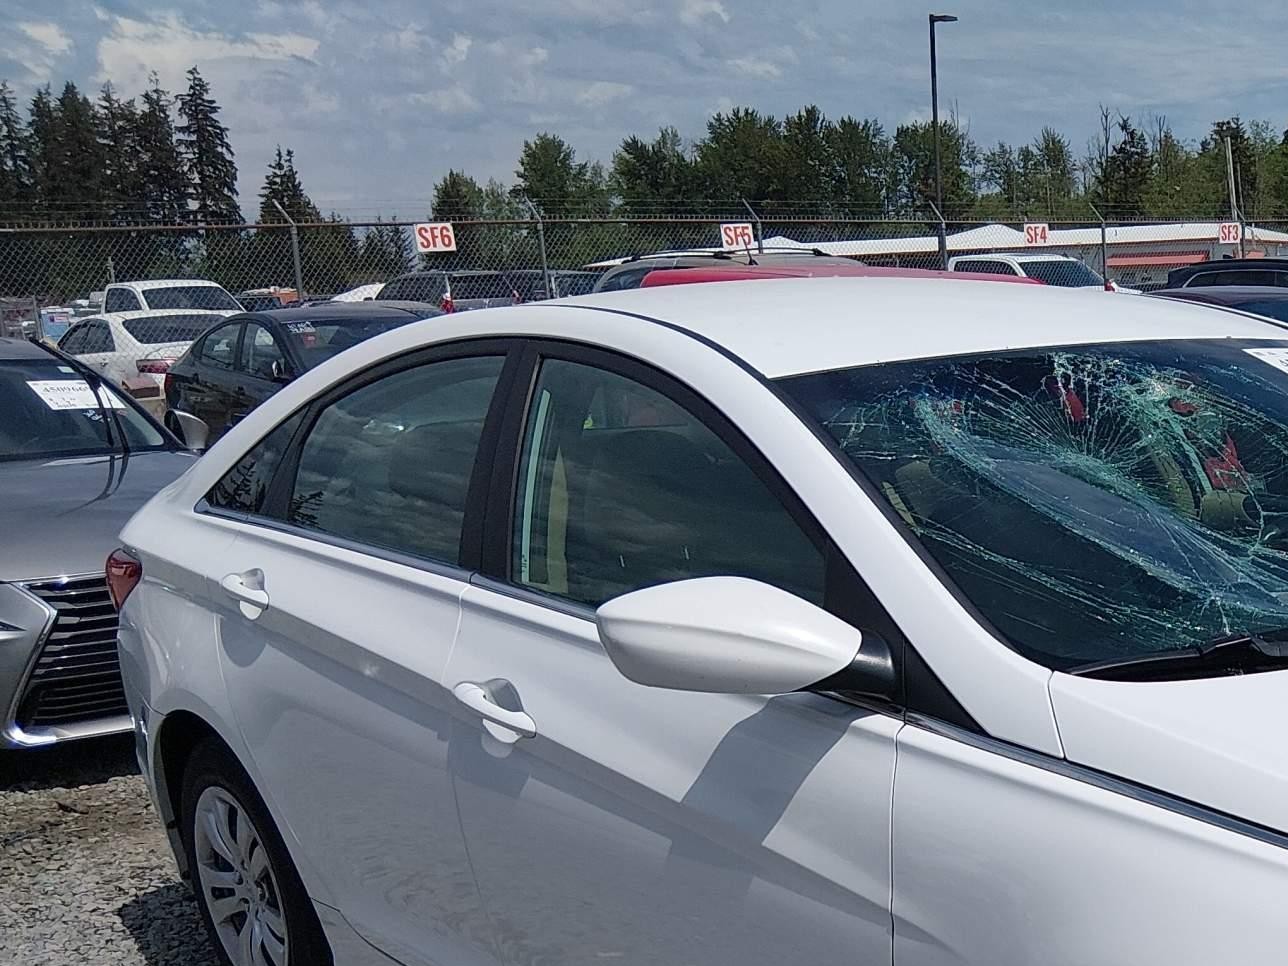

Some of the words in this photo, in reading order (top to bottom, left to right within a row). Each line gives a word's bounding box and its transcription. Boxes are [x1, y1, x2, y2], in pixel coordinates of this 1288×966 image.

[417, 226, 453, 249] SF6
[723, 225, 752, 246] SF5
[1026, 225, 1047, 244] SF4
[1221, 224, 1239, 241] SF3
